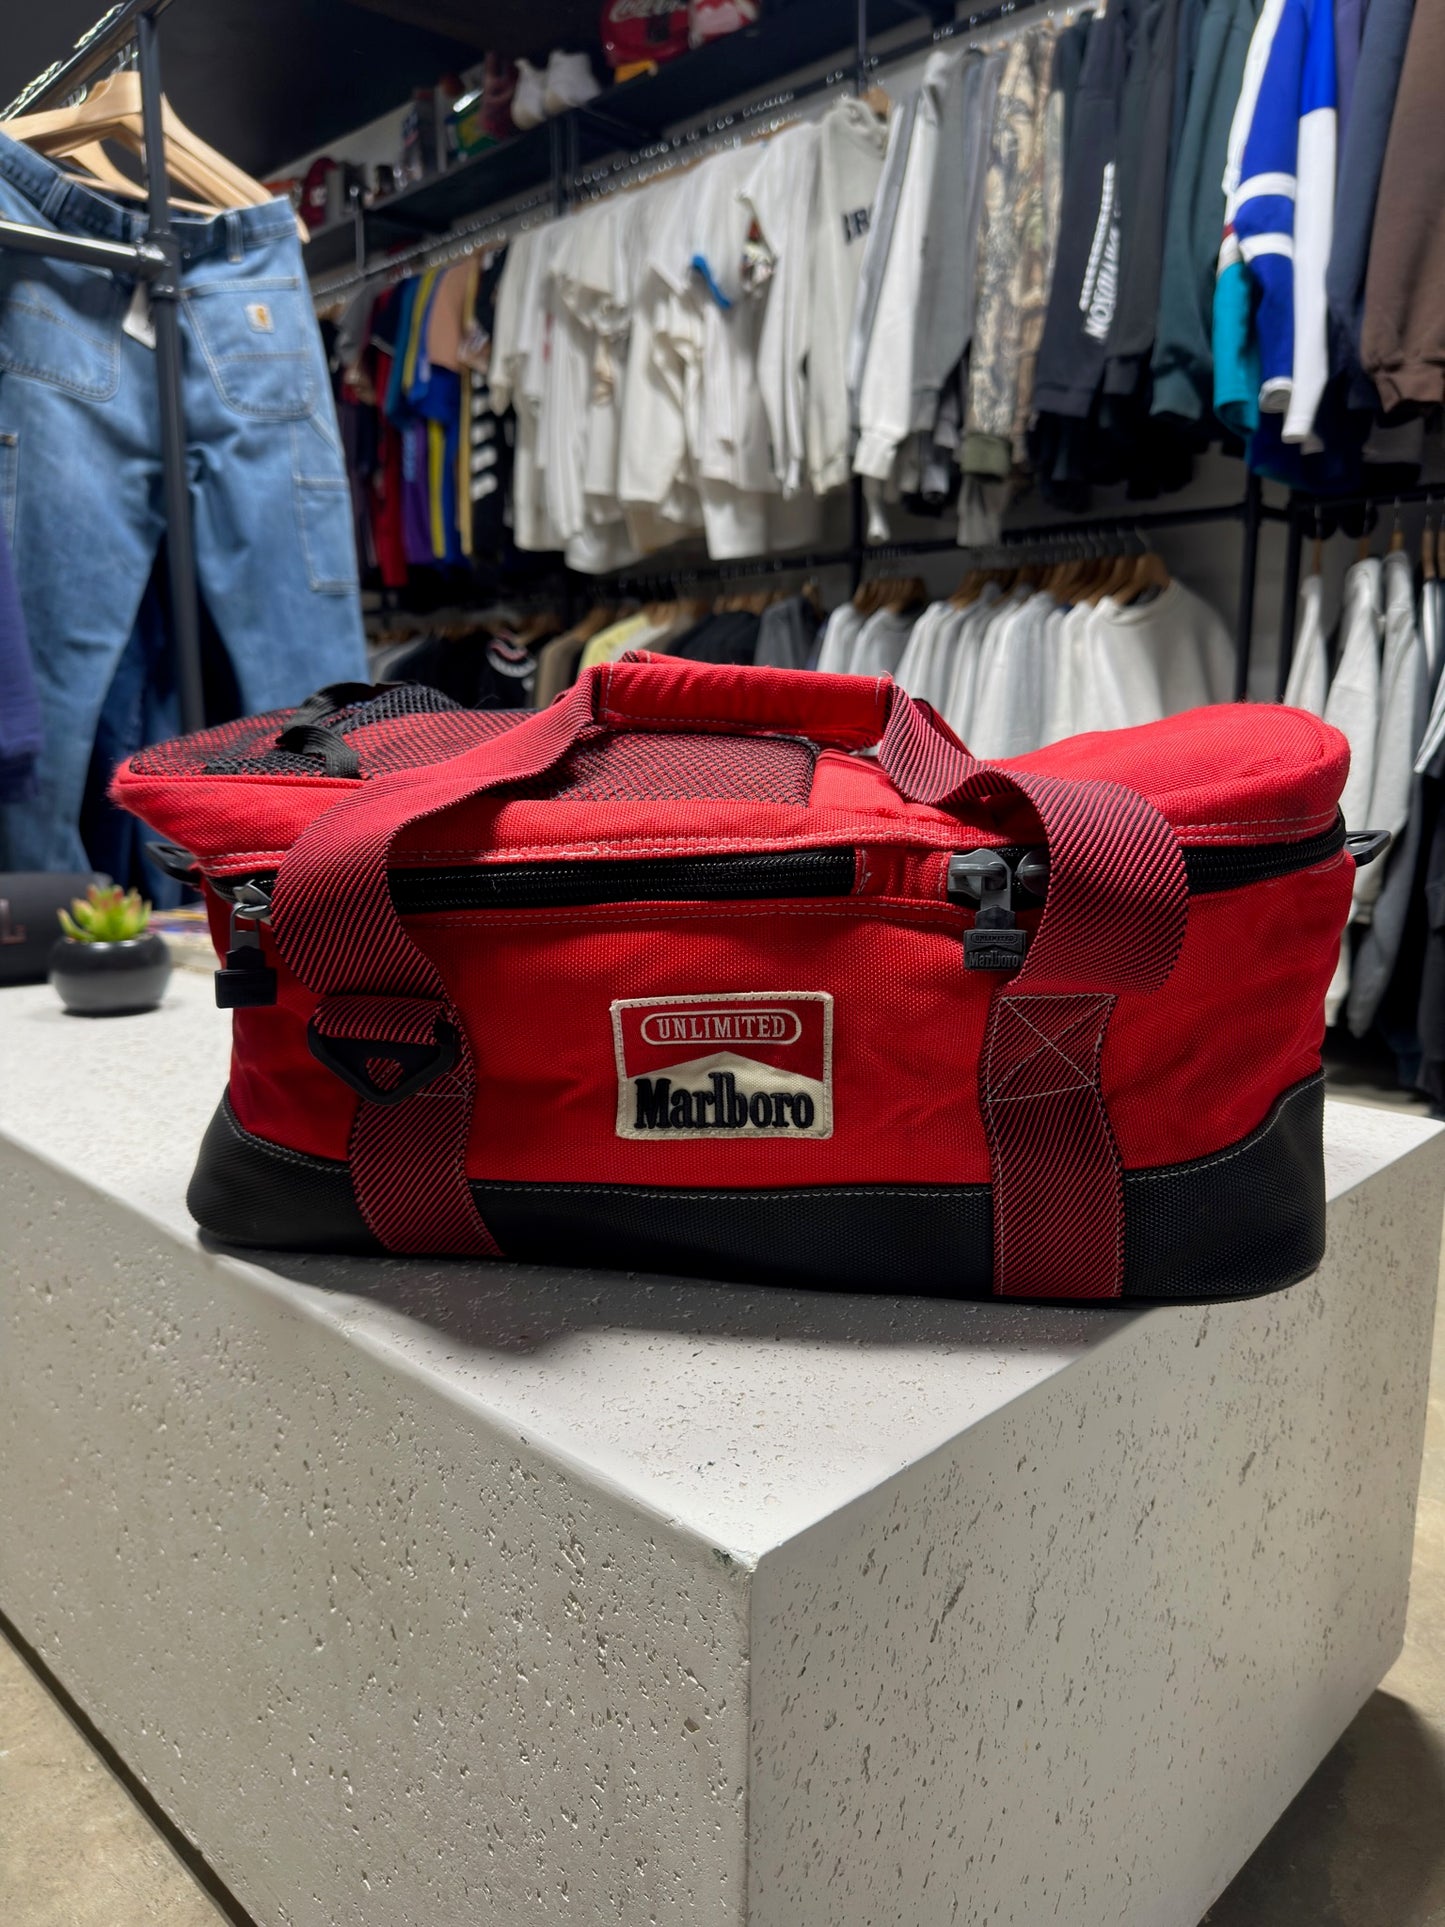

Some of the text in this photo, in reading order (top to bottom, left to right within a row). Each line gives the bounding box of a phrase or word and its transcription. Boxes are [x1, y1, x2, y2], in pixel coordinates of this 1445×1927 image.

[974, 934, 1015, 943] UNLIMITED
[969, 950, 1019, 967] Marlboro
[656, 1015, 786, 1039] UNLIMITED
[634, 1072, 815, 1129] Marlboro
